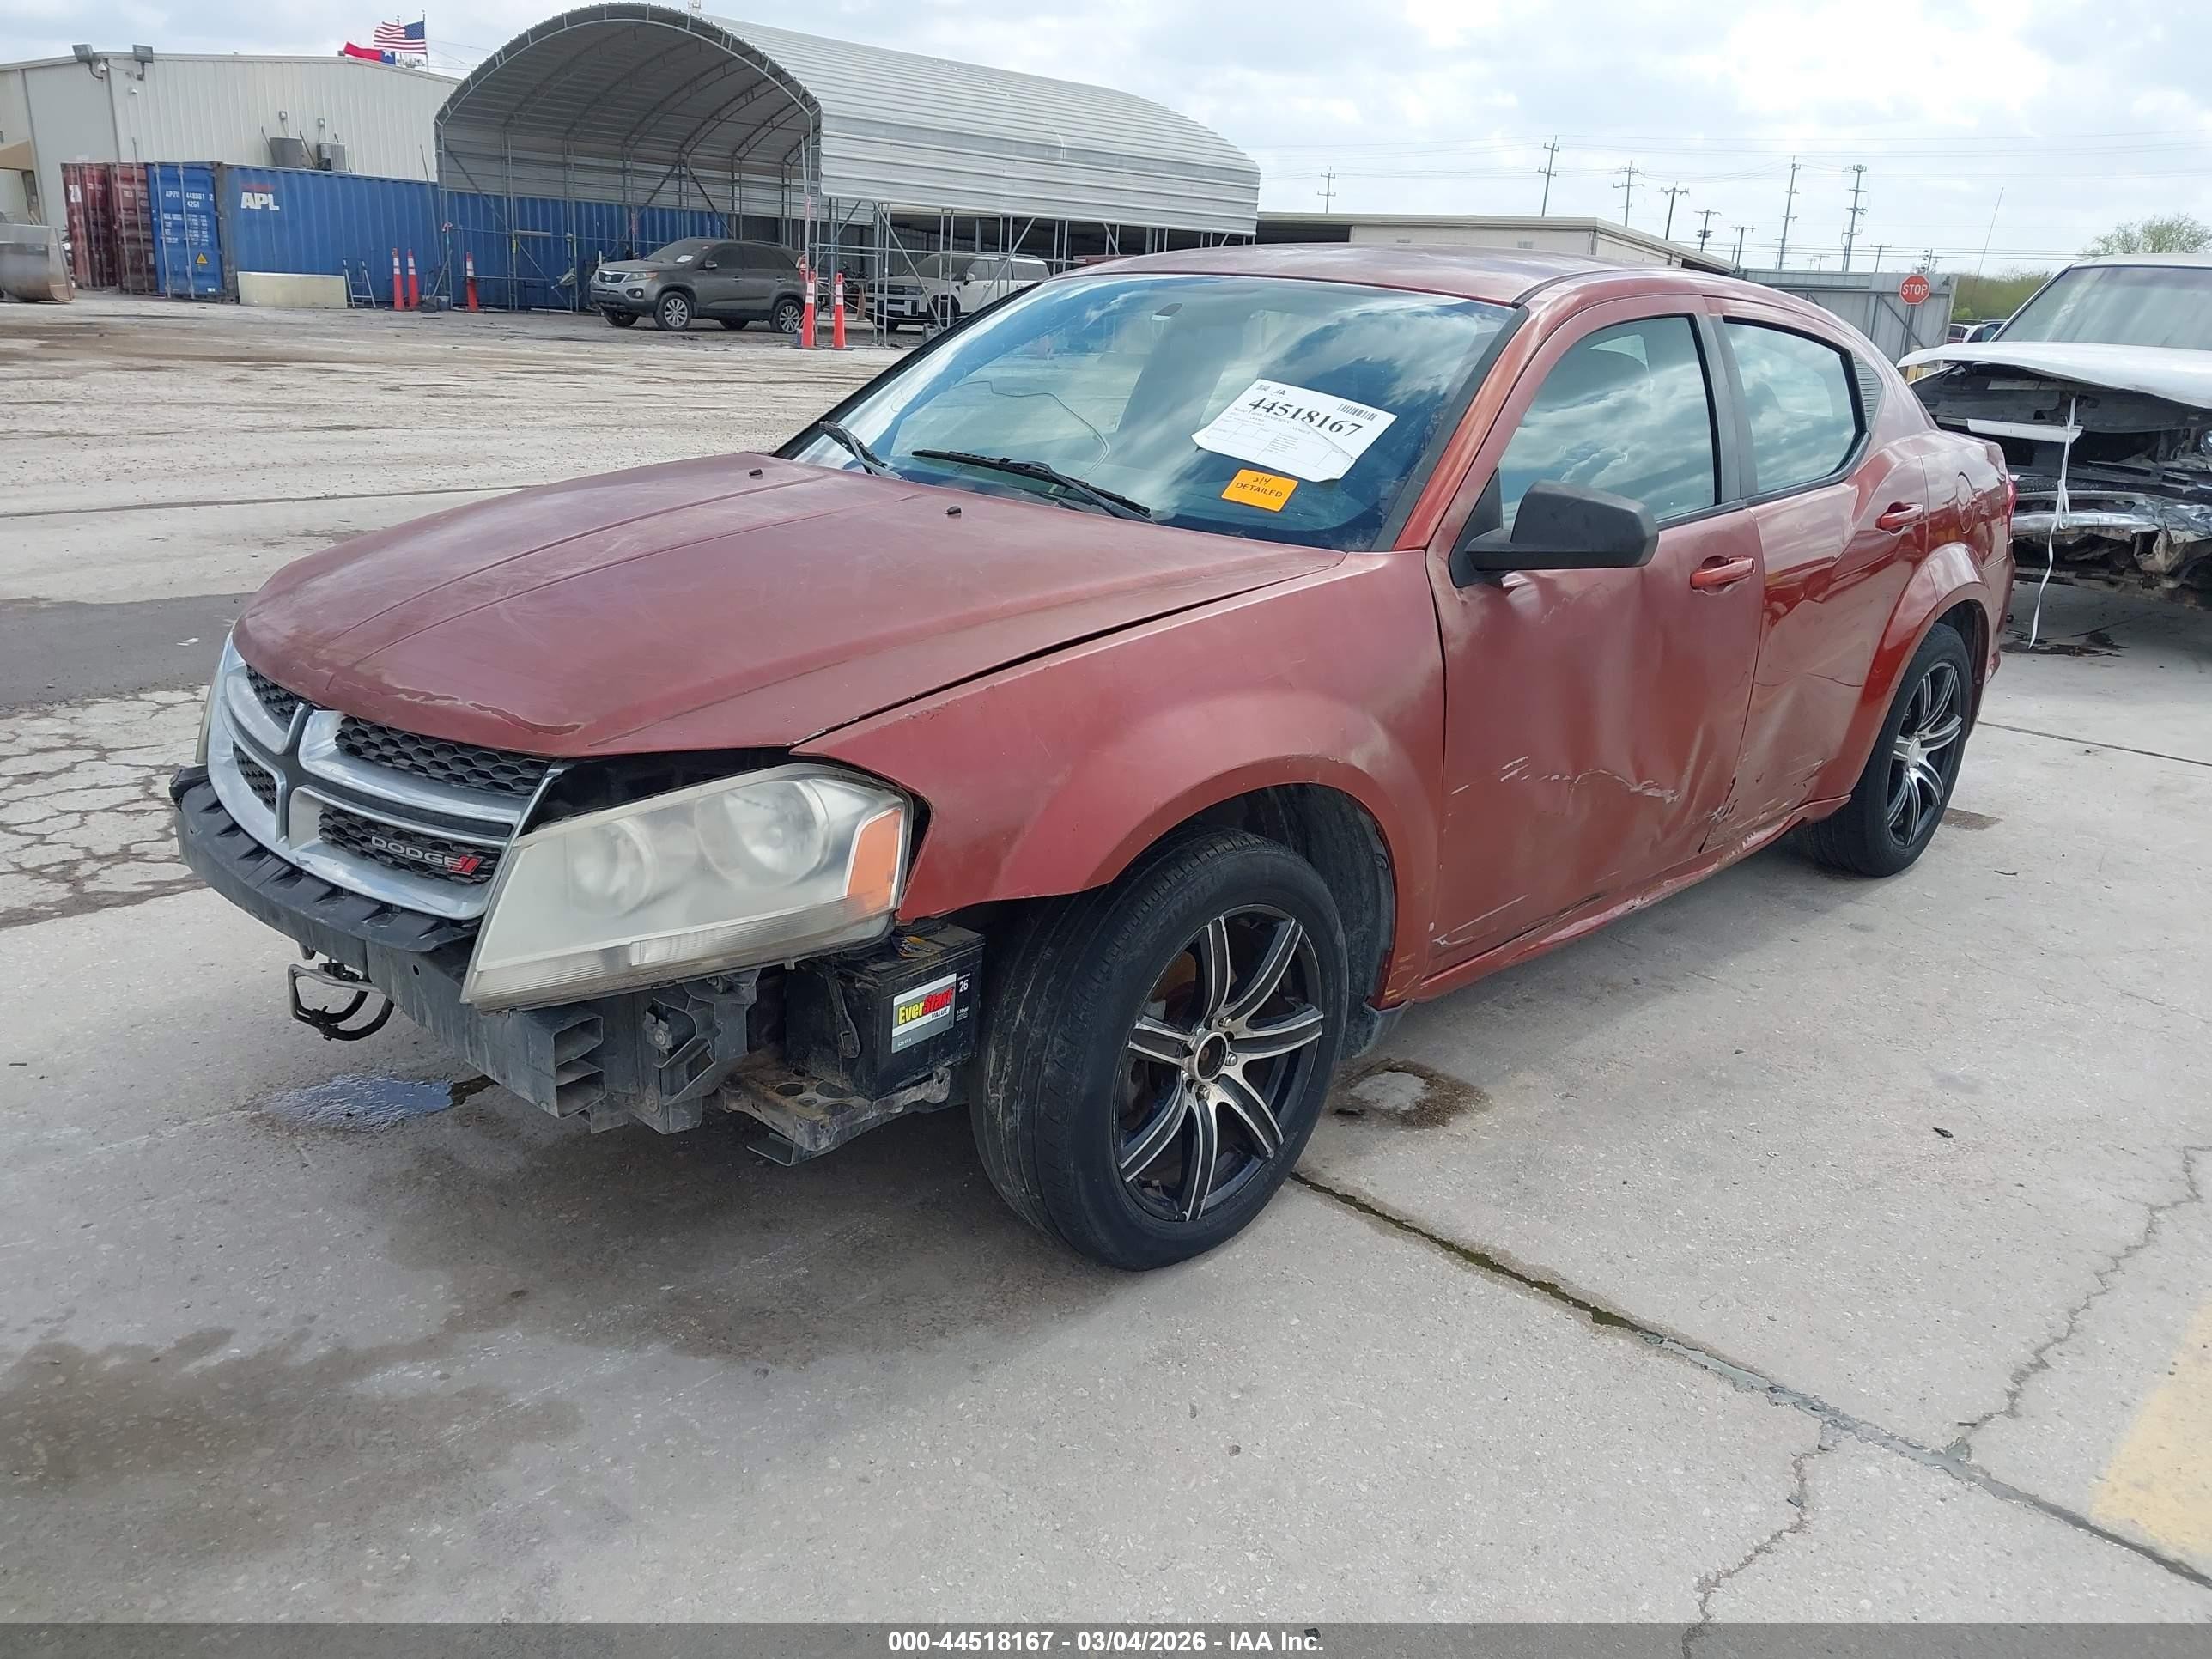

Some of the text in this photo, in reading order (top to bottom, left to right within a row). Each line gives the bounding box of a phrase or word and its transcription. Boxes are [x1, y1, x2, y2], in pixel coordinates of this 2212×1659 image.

[240, 191, 280, 210] APL
[1902, 283, 1928, 295] STOP
[1249, 397, 1364, 438] 44518167
[1236, 482, 1283, 498] DETAILED
[371, 836, 464, 869] DODGE
[898, 987, 954, 1025] EverStart
